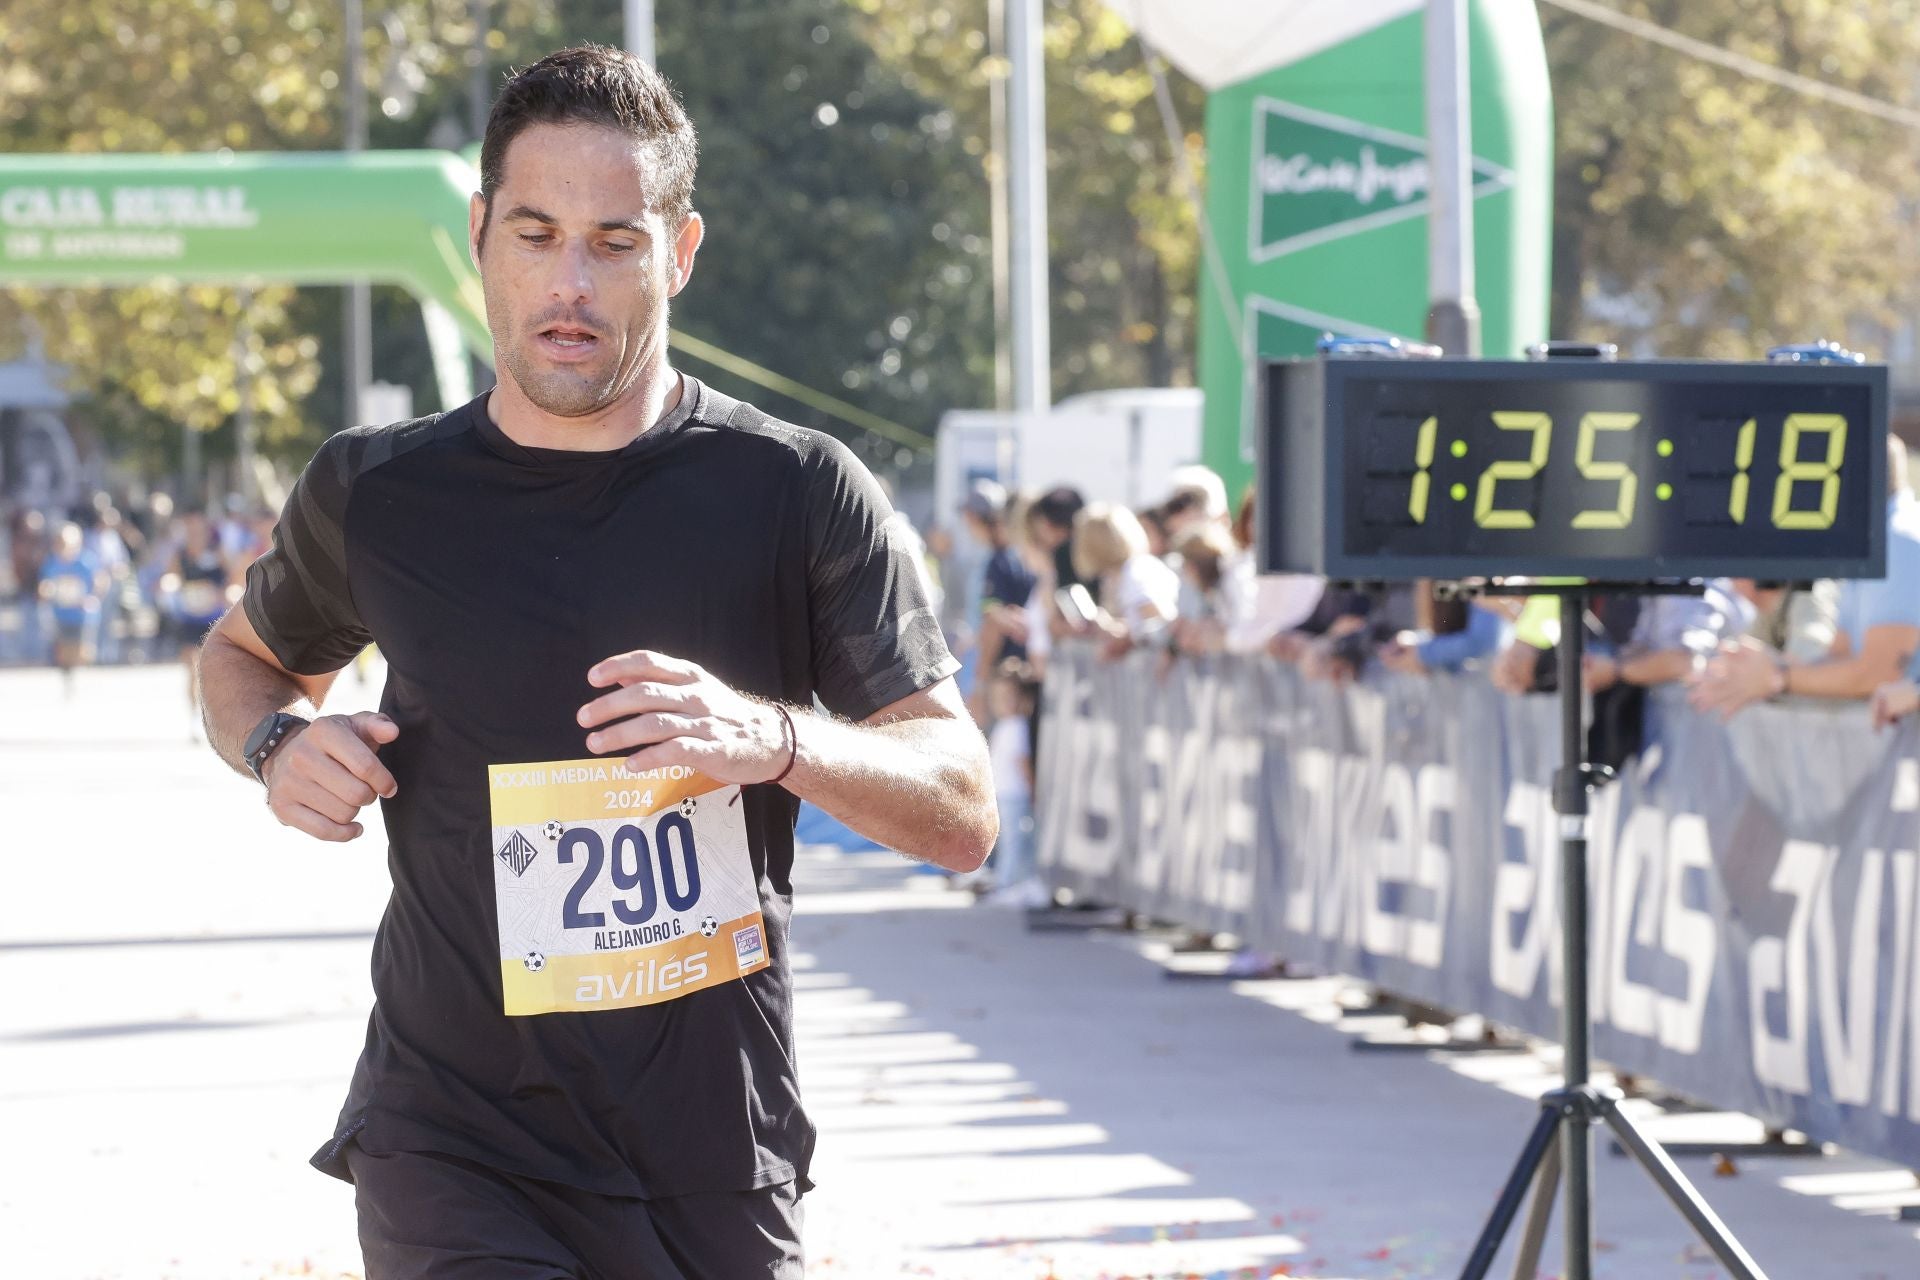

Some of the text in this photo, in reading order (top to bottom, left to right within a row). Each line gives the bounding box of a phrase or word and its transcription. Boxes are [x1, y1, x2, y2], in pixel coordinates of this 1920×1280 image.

[1408, 411, 1848, 530] 1:25:18
[492, 768, 547, 789] XXXIII
[551, 765, 608, 785] MEDIA
[604, 789, 653, 810] 2024
[557, 811, 701, 929] 290
[594, 918, 685, 950] ALEJANDRO G.
[576, 952, 708, 1002] avilés
